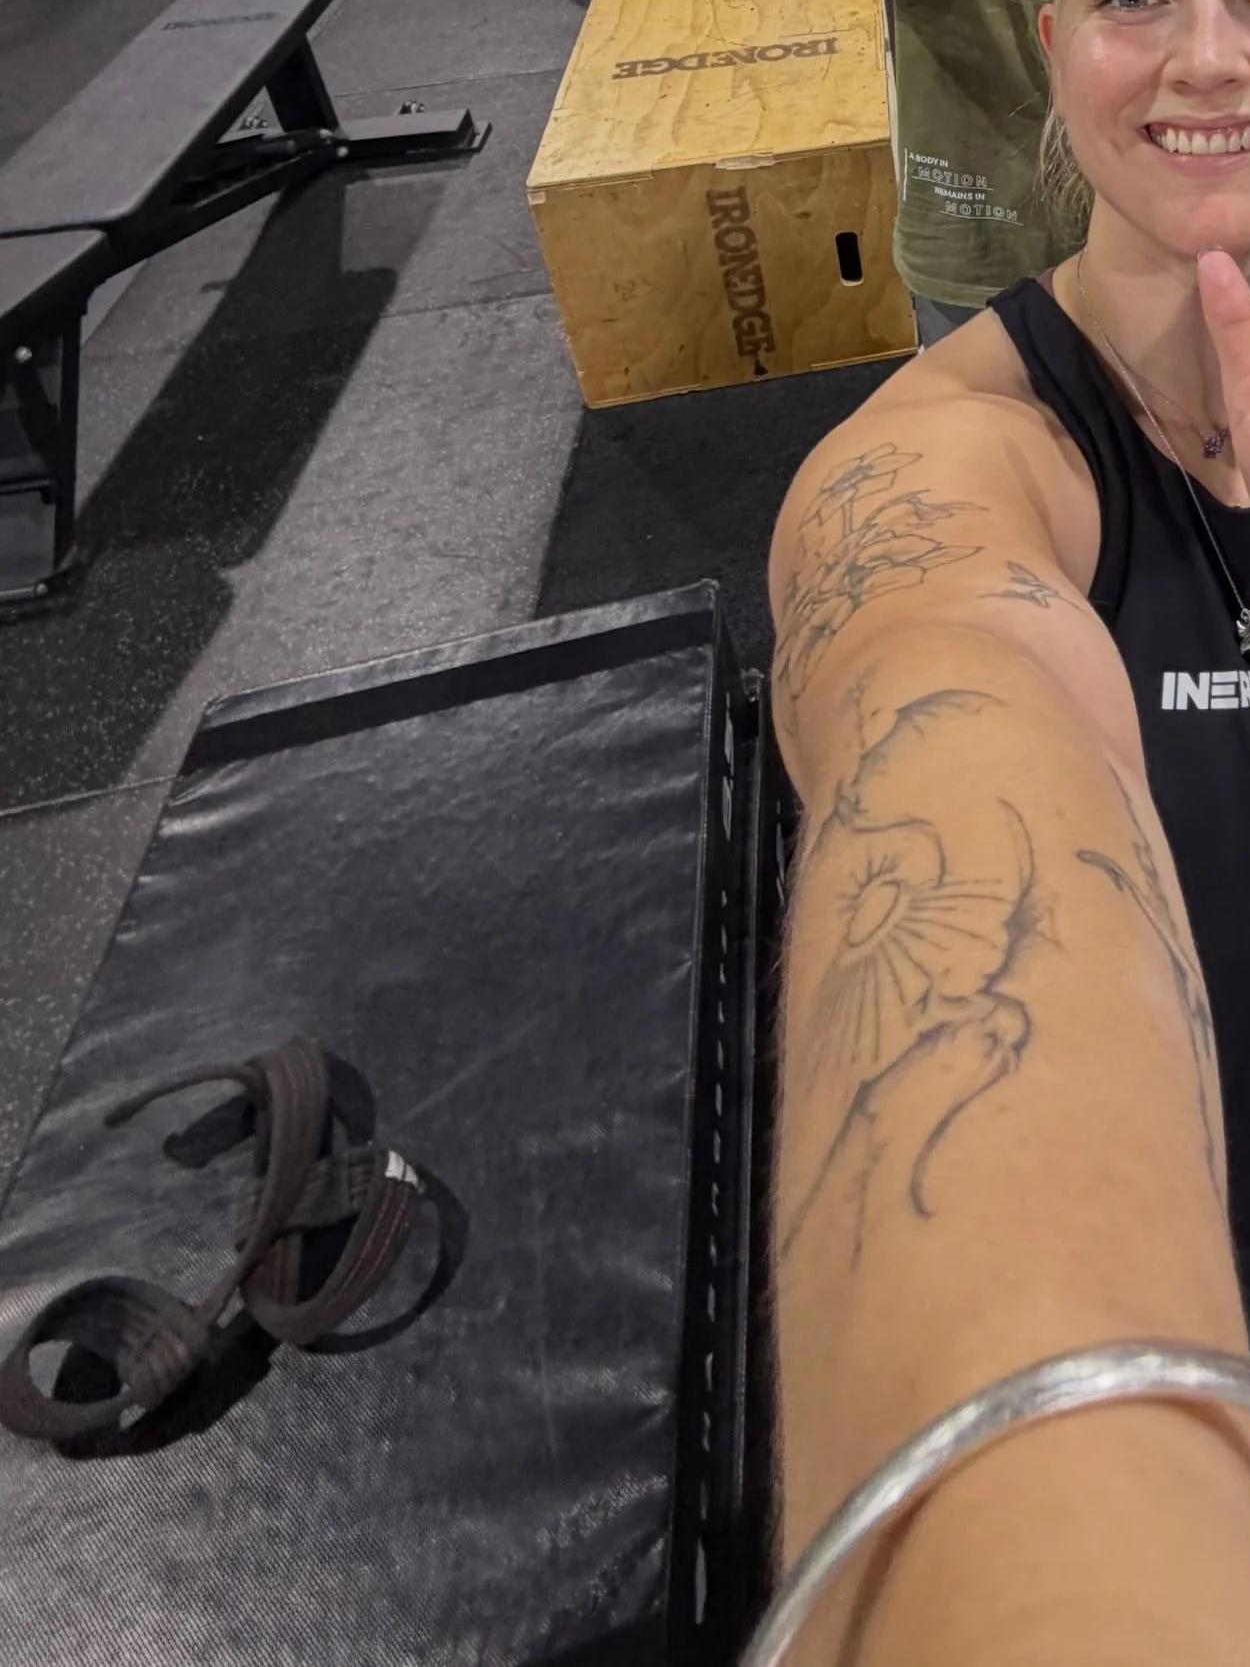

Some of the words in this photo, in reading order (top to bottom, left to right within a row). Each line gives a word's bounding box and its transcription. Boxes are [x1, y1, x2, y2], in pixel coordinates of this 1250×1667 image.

[612, 36, 840, 80] IRONEDGE
[915, 154, 938, 165] BODY
[940, 159, 949, 168] IN
[918, 166, 987, 188] MOTION
[934, 186, 973, 200] REMAINS
[975, 192, 986, 201] IN
[945, 200, 1018, 222] MOTION
[705, 185, 775, 357] IRONEDGE
